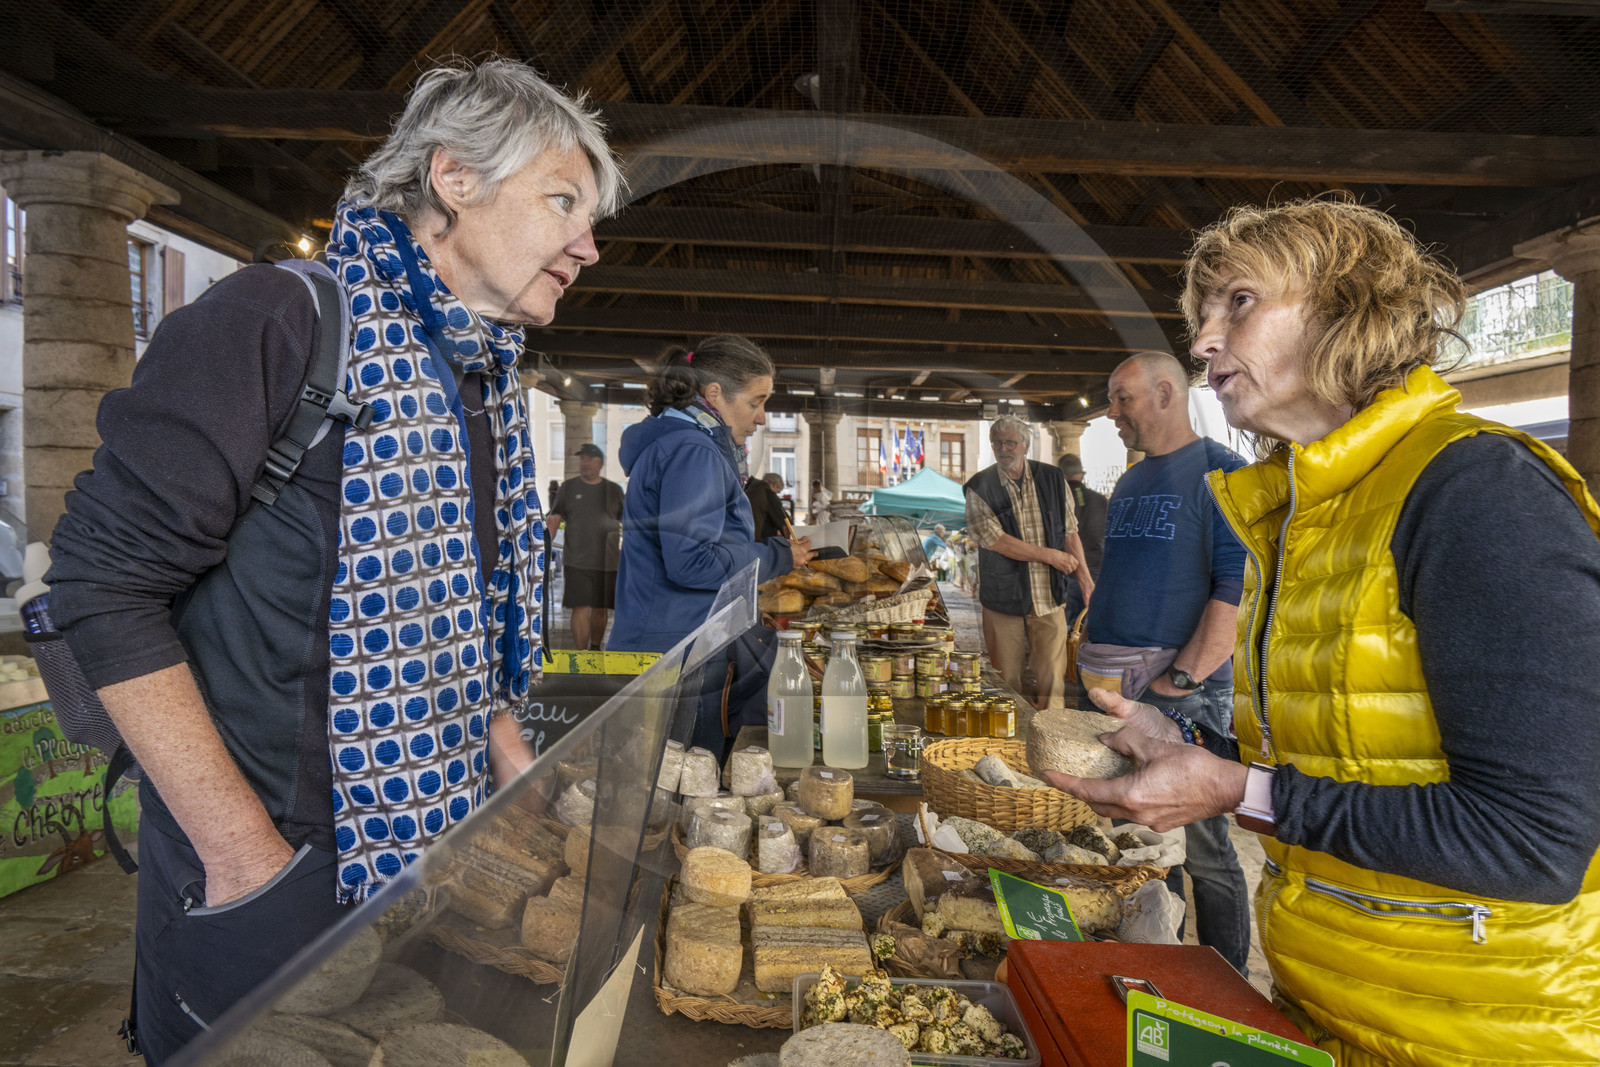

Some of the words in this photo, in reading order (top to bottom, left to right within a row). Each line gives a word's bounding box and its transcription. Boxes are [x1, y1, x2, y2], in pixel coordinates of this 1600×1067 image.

[846, 492, 870, 500] MA
[1140, 1025, 1164, 1047] AB
[1232, 1025, 1243, 1037] la
